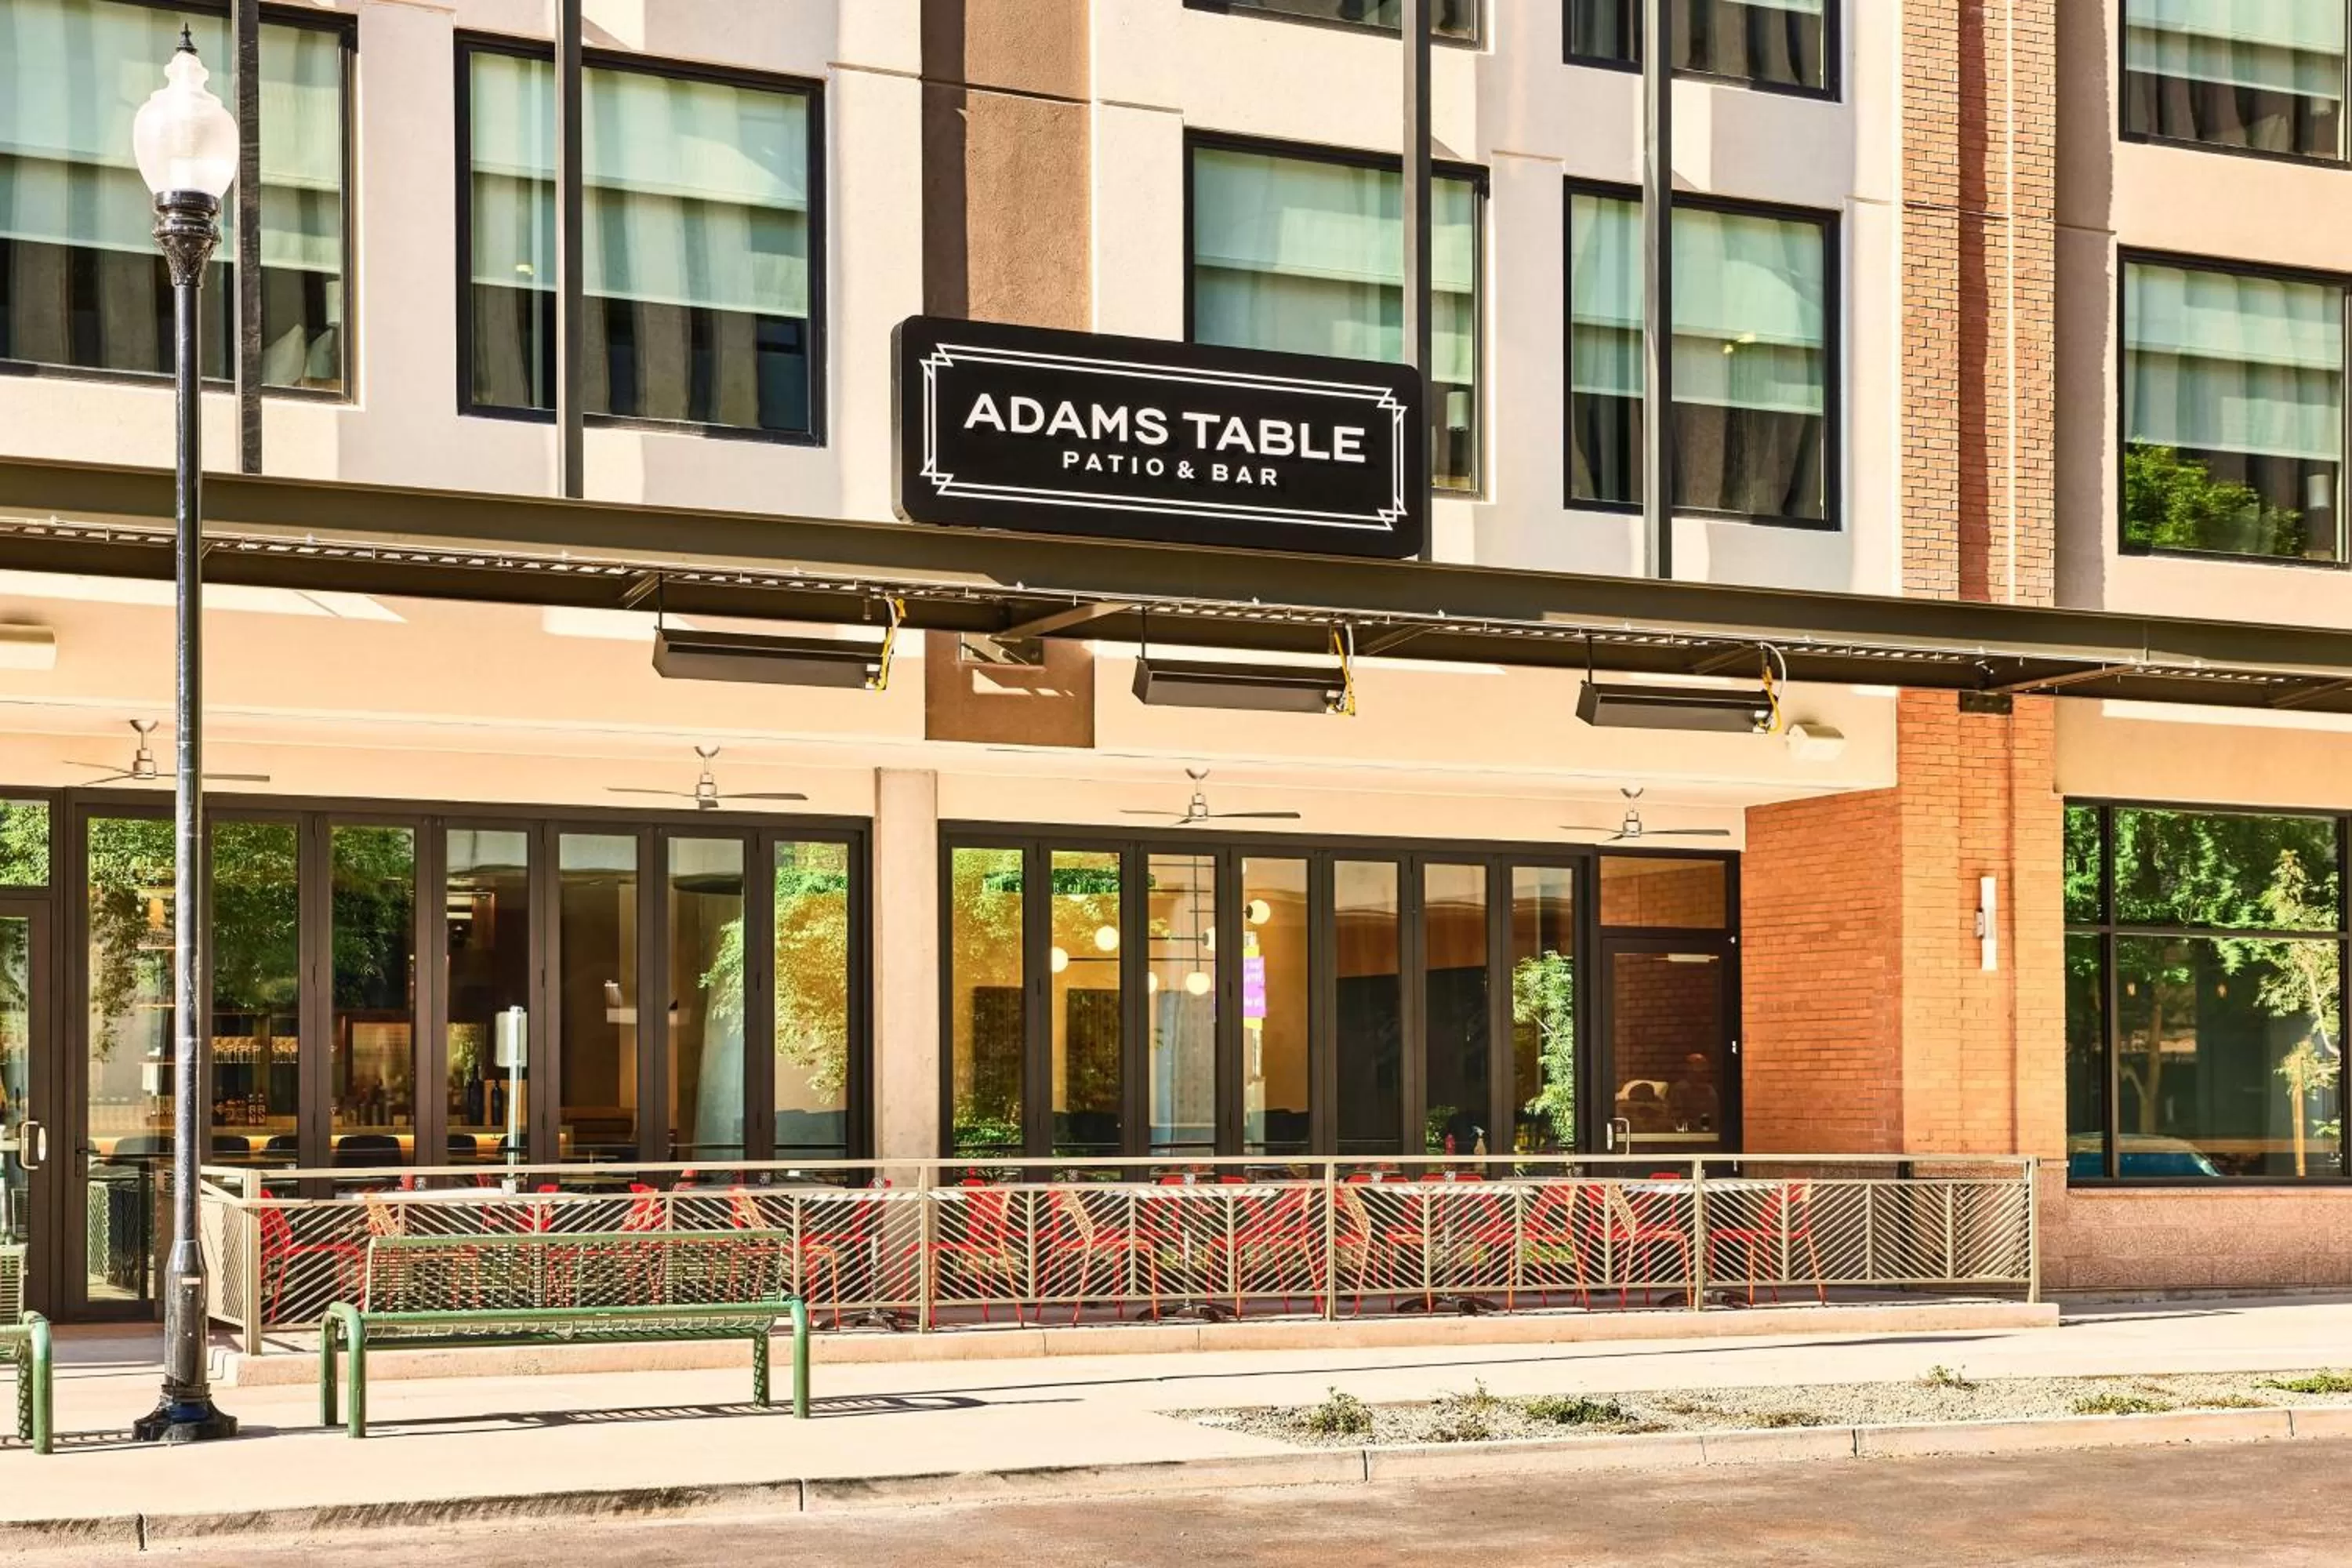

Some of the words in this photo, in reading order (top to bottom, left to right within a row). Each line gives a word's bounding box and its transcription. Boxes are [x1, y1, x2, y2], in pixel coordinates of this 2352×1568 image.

[964, 393, 1169, 446] ADAMS
[1181, 412, 1366, 463] TABLE
[1062, 451, 1164, 477] PATIO
[1177, 460, 1196, 479] &
[1211, 463, 1277, 486] BAR
